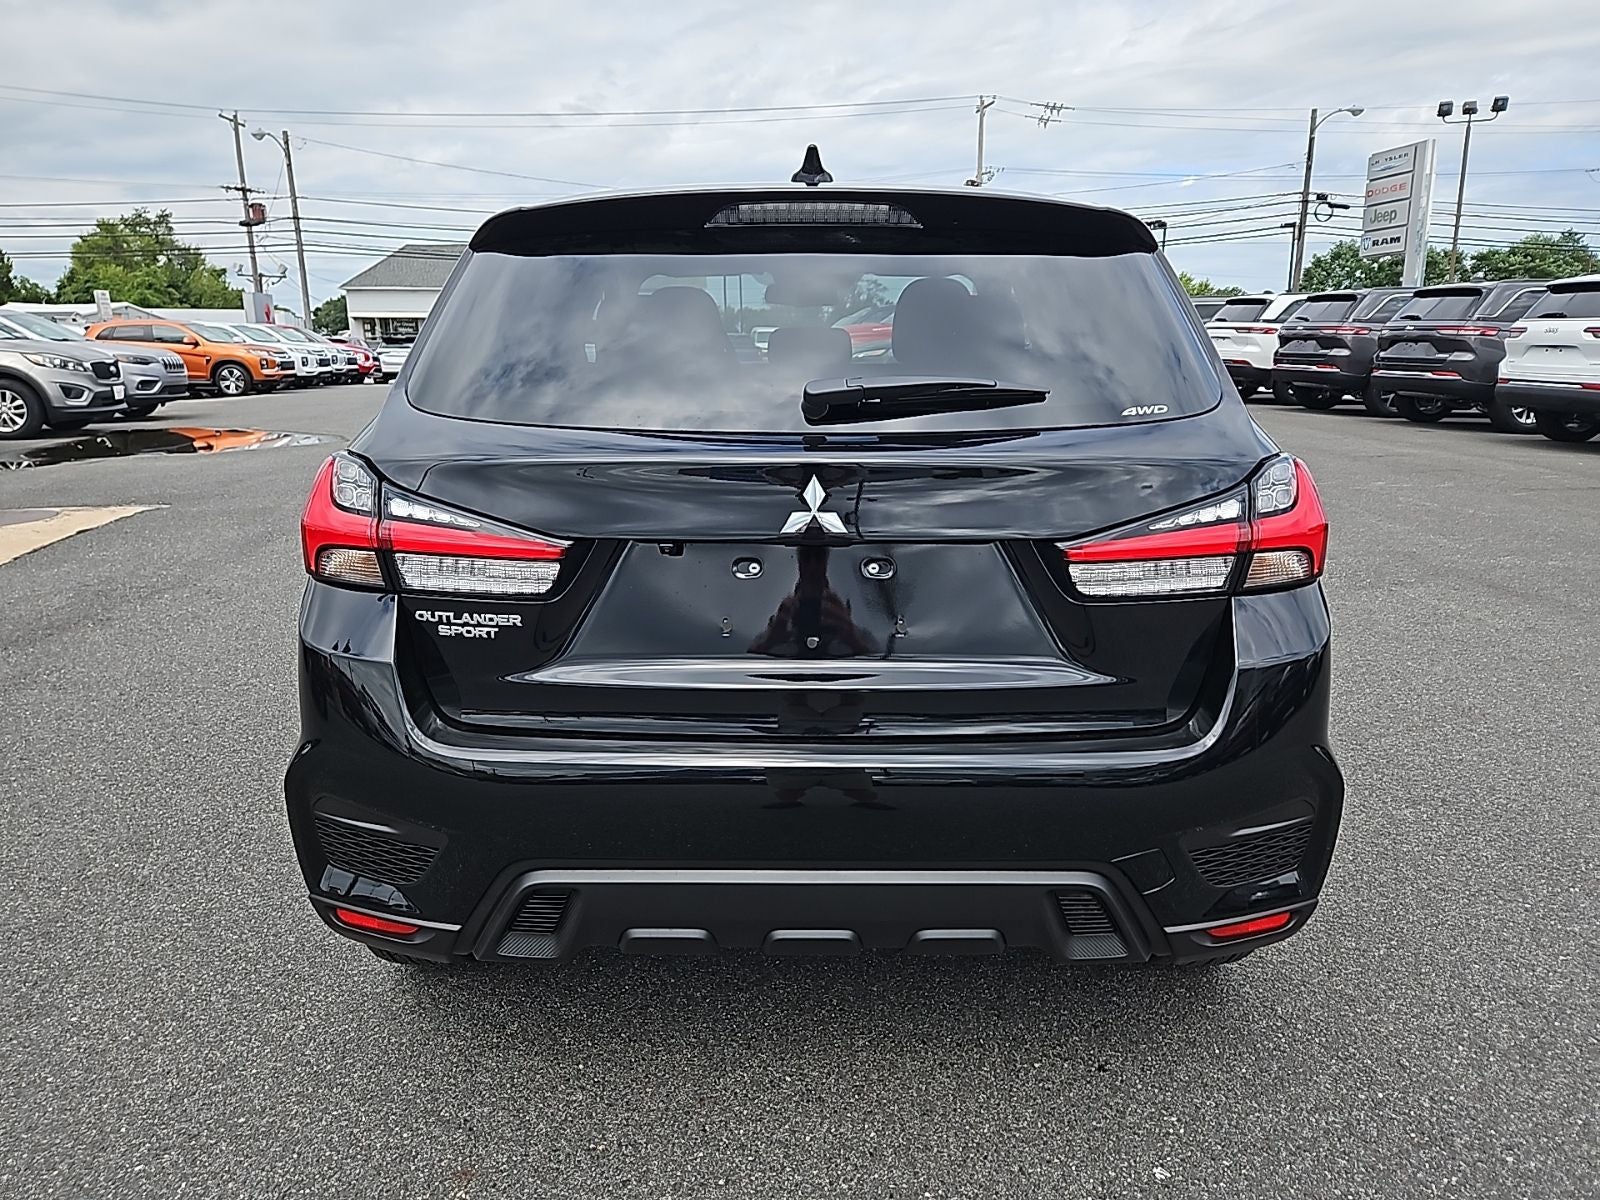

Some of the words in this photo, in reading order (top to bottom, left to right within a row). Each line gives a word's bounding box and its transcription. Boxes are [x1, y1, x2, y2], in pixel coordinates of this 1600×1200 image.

[1367, 182, 1408, 198] DODGE
[1369, 208, 1398, 224] Jeep
[1371, 235, 1402, 248] RAM
[1120, 404, 1169, 417] 4WD
[414, 610, 523, 627] OUTLANDER
[437, 624, 499, 639] SPORT
